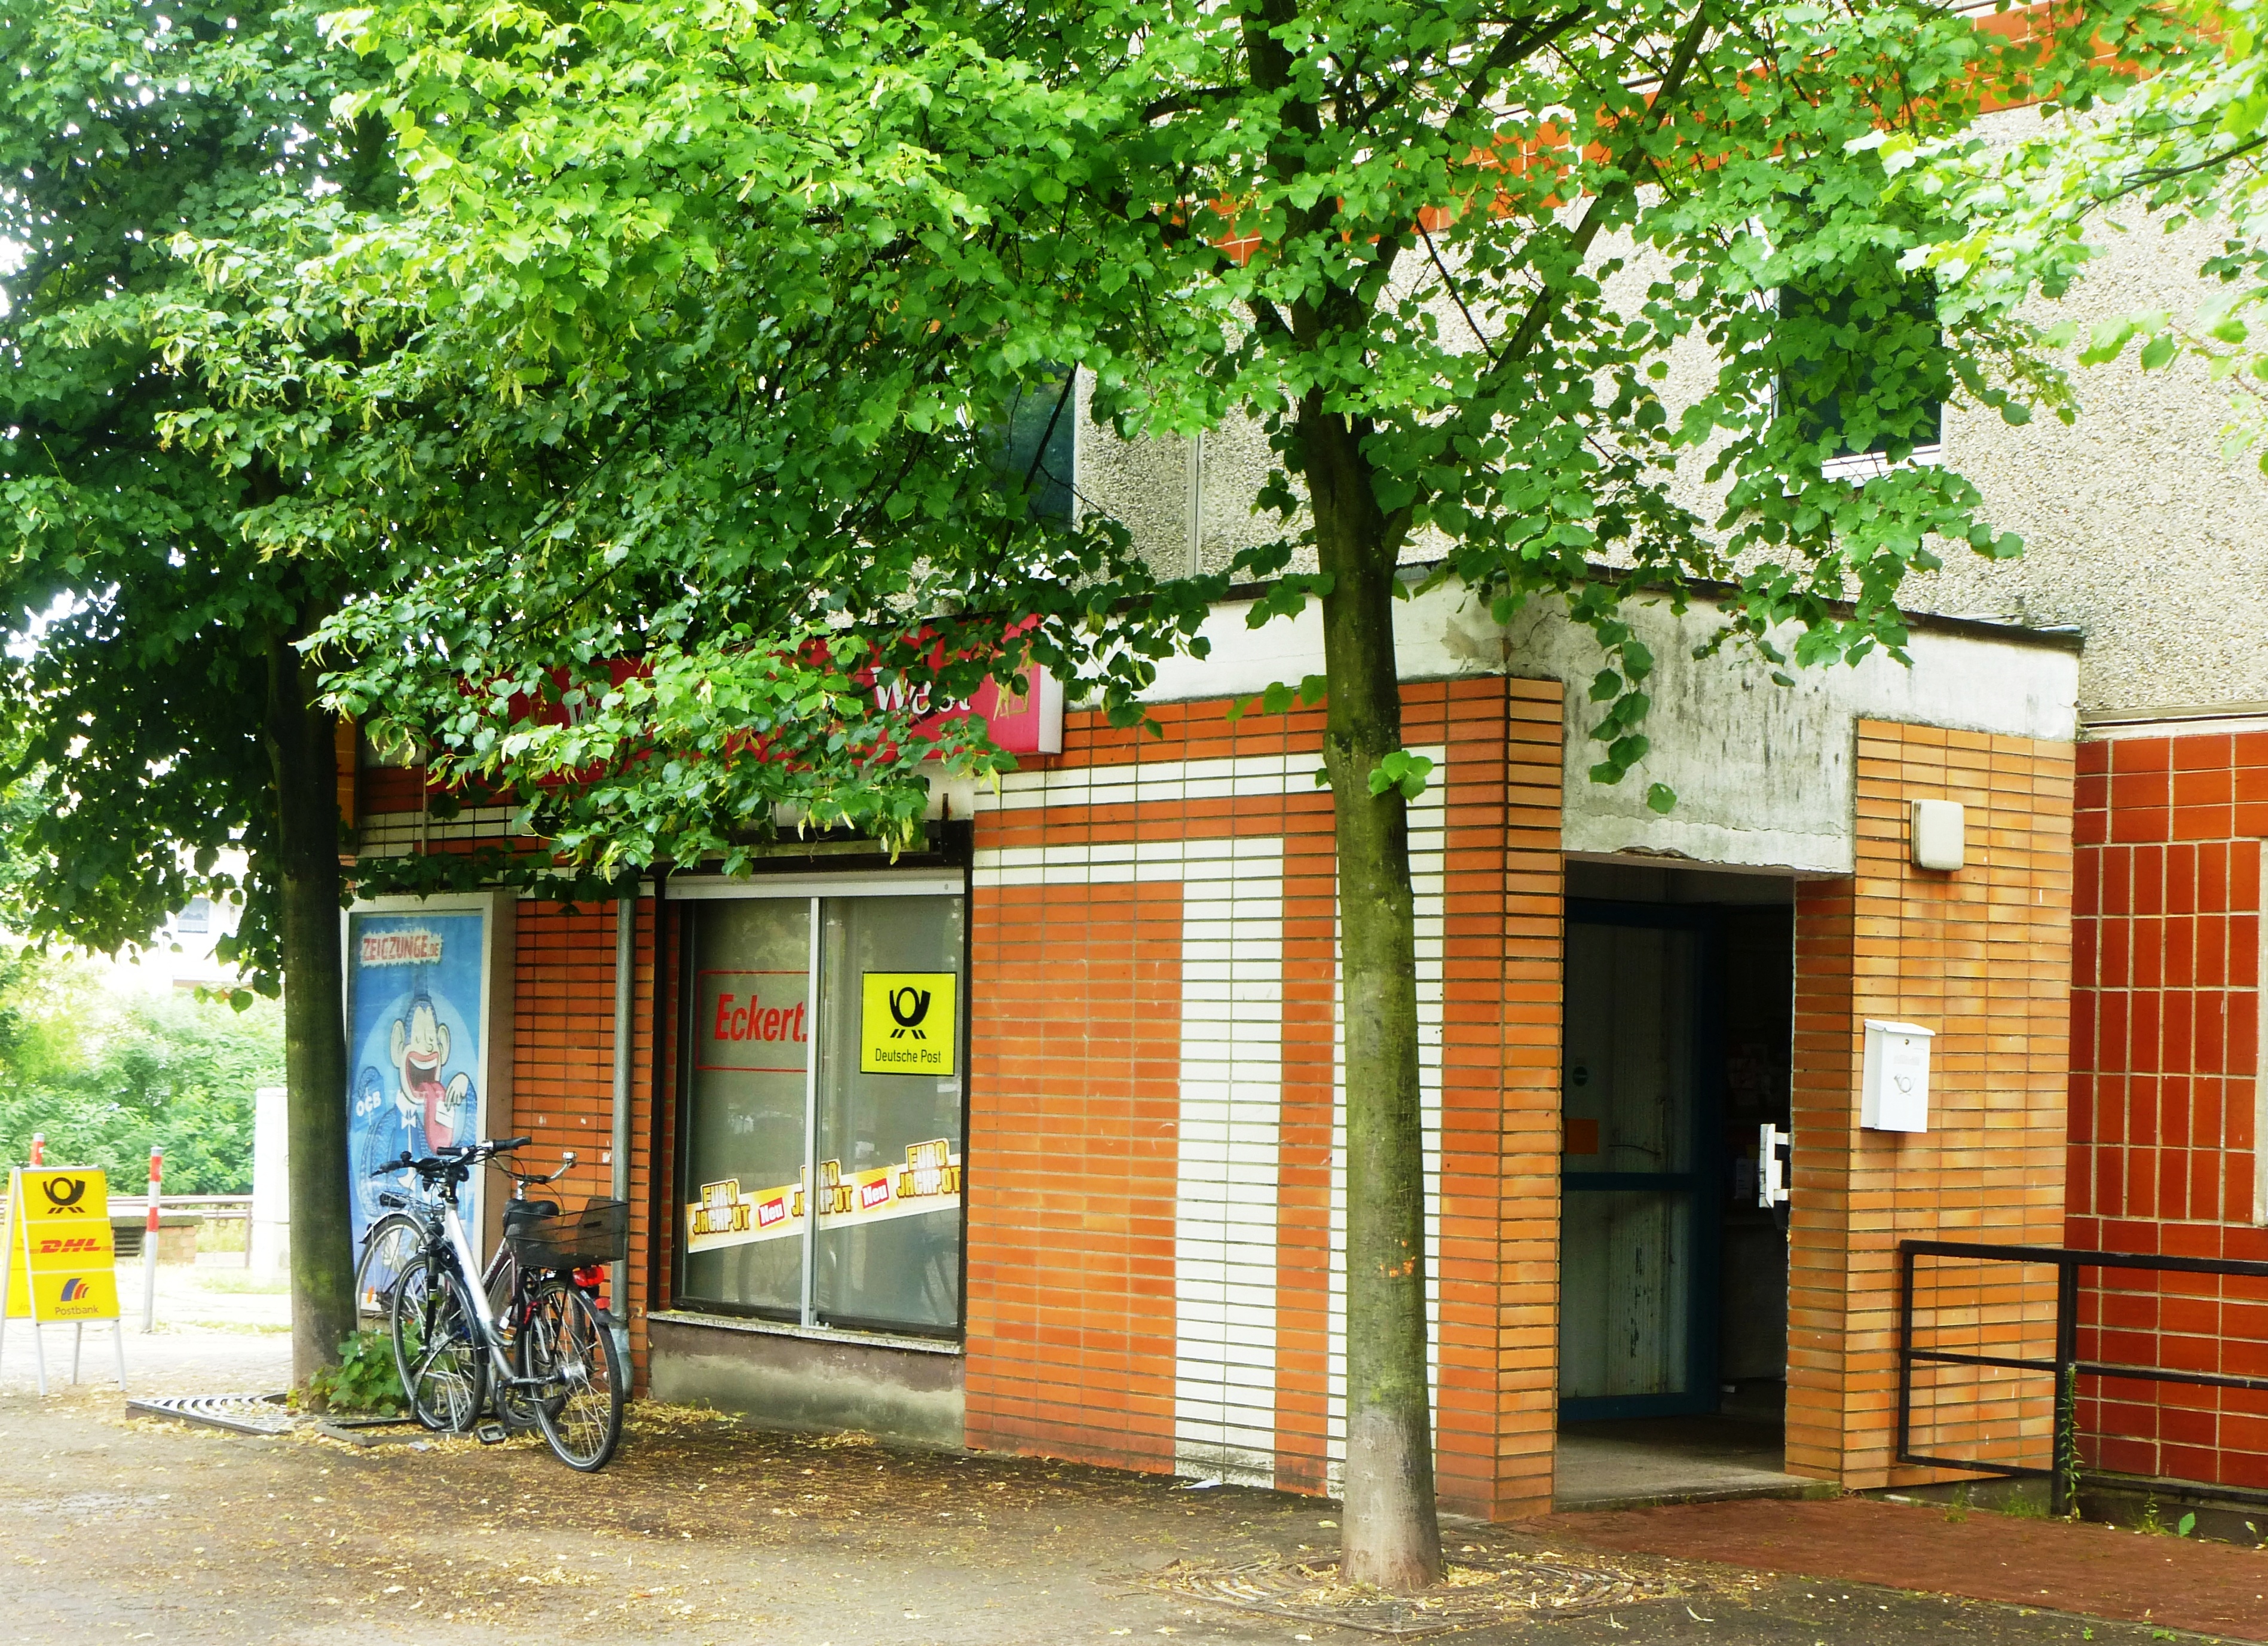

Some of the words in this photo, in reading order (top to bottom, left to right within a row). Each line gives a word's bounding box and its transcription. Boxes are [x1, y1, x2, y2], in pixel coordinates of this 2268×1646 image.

[876, 1048, 918, 1062] Deutsche
[921, 1049, 941, 1063] Post
[356, 1091, 381, 1117] OCB
[907, 1140, 946, 1170] EURO
[702, 1181, 737, 1209] EURO
[862, 1184, 888, 1206] Neu
[896, 1166, 961, 1199] JACKPOT
[759, 1203, 783, 1225] Neu
[791, 1185, 852, 1217] JAPOT
[693, 1204, 750, 1235] JACKPOT
[40, 1239, 101, 1253] DHL
[55, 1305, 99, 1315] Postbank
